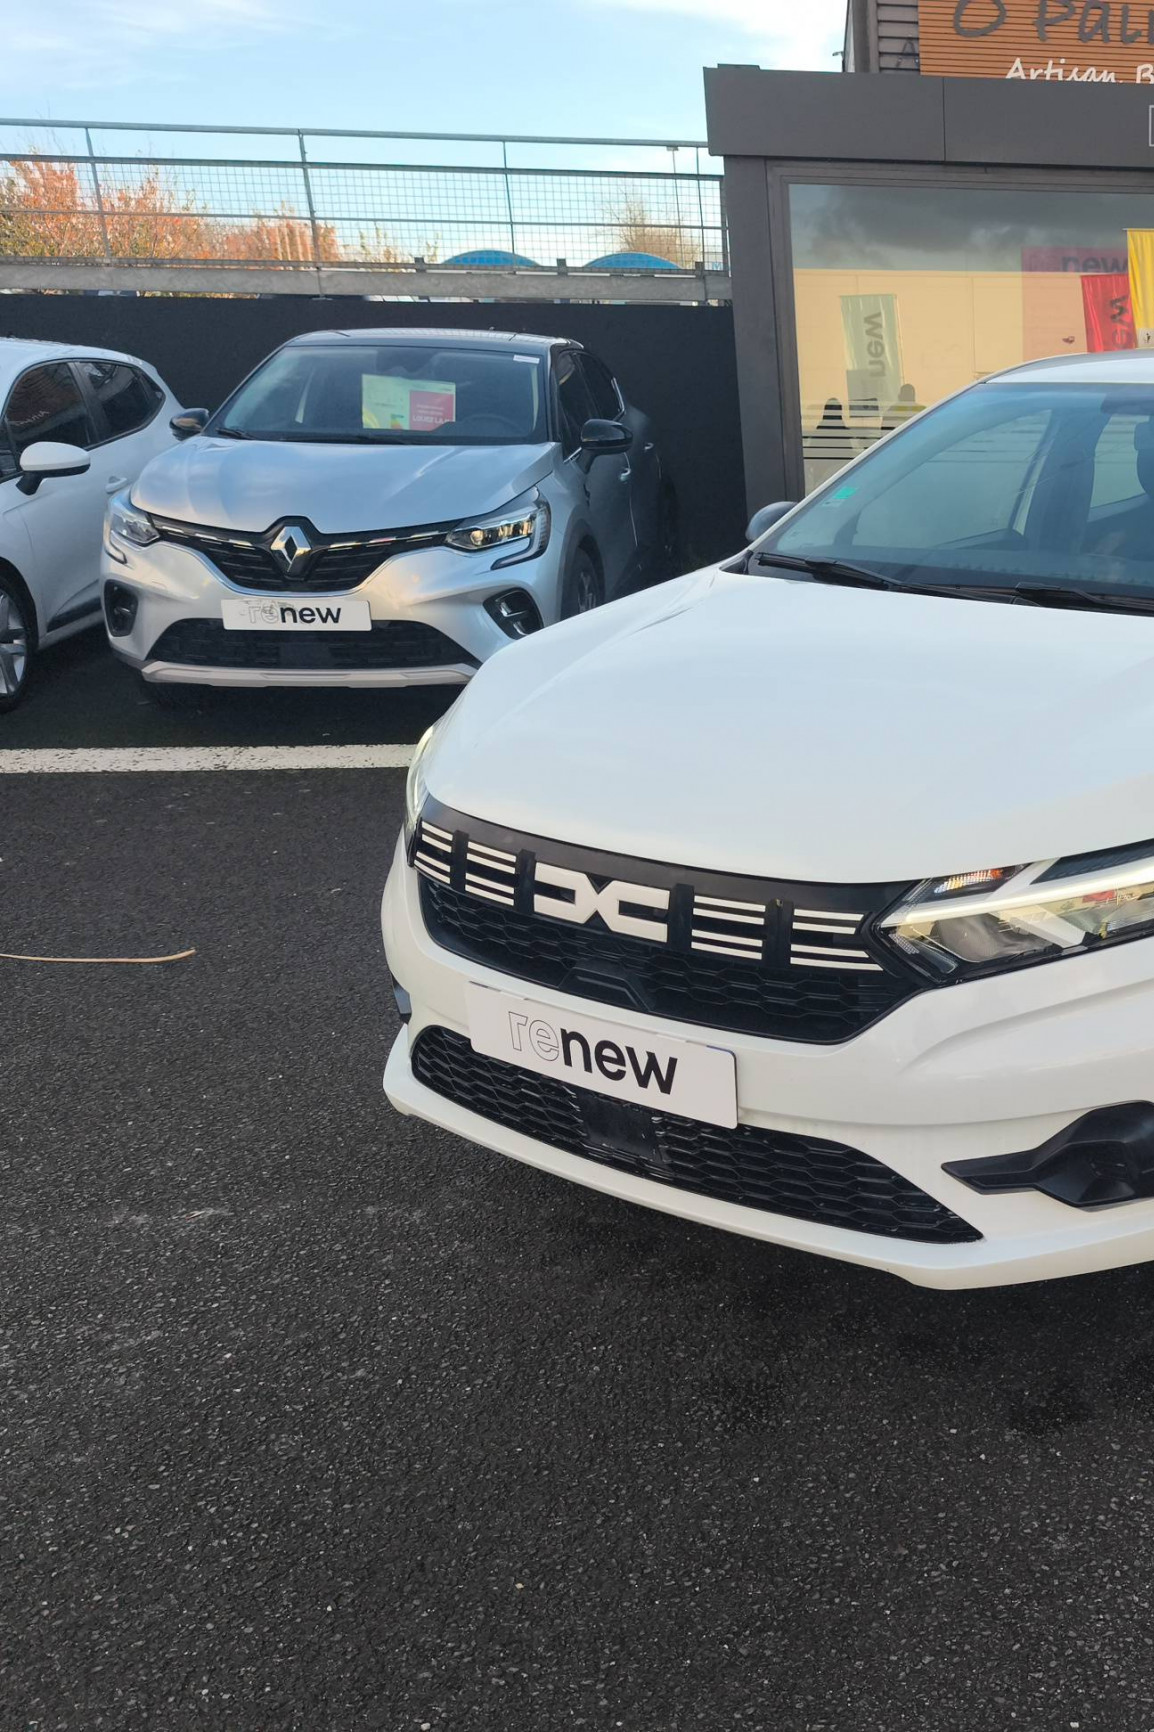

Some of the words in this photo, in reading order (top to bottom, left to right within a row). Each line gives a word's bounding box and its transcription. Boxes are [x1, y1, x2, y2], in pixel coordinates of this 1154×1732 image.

[1005, 57, 1118, 83] Artisan
[249, 604, 342, 624] renew
[507, 1010, 679, 1095] renew
